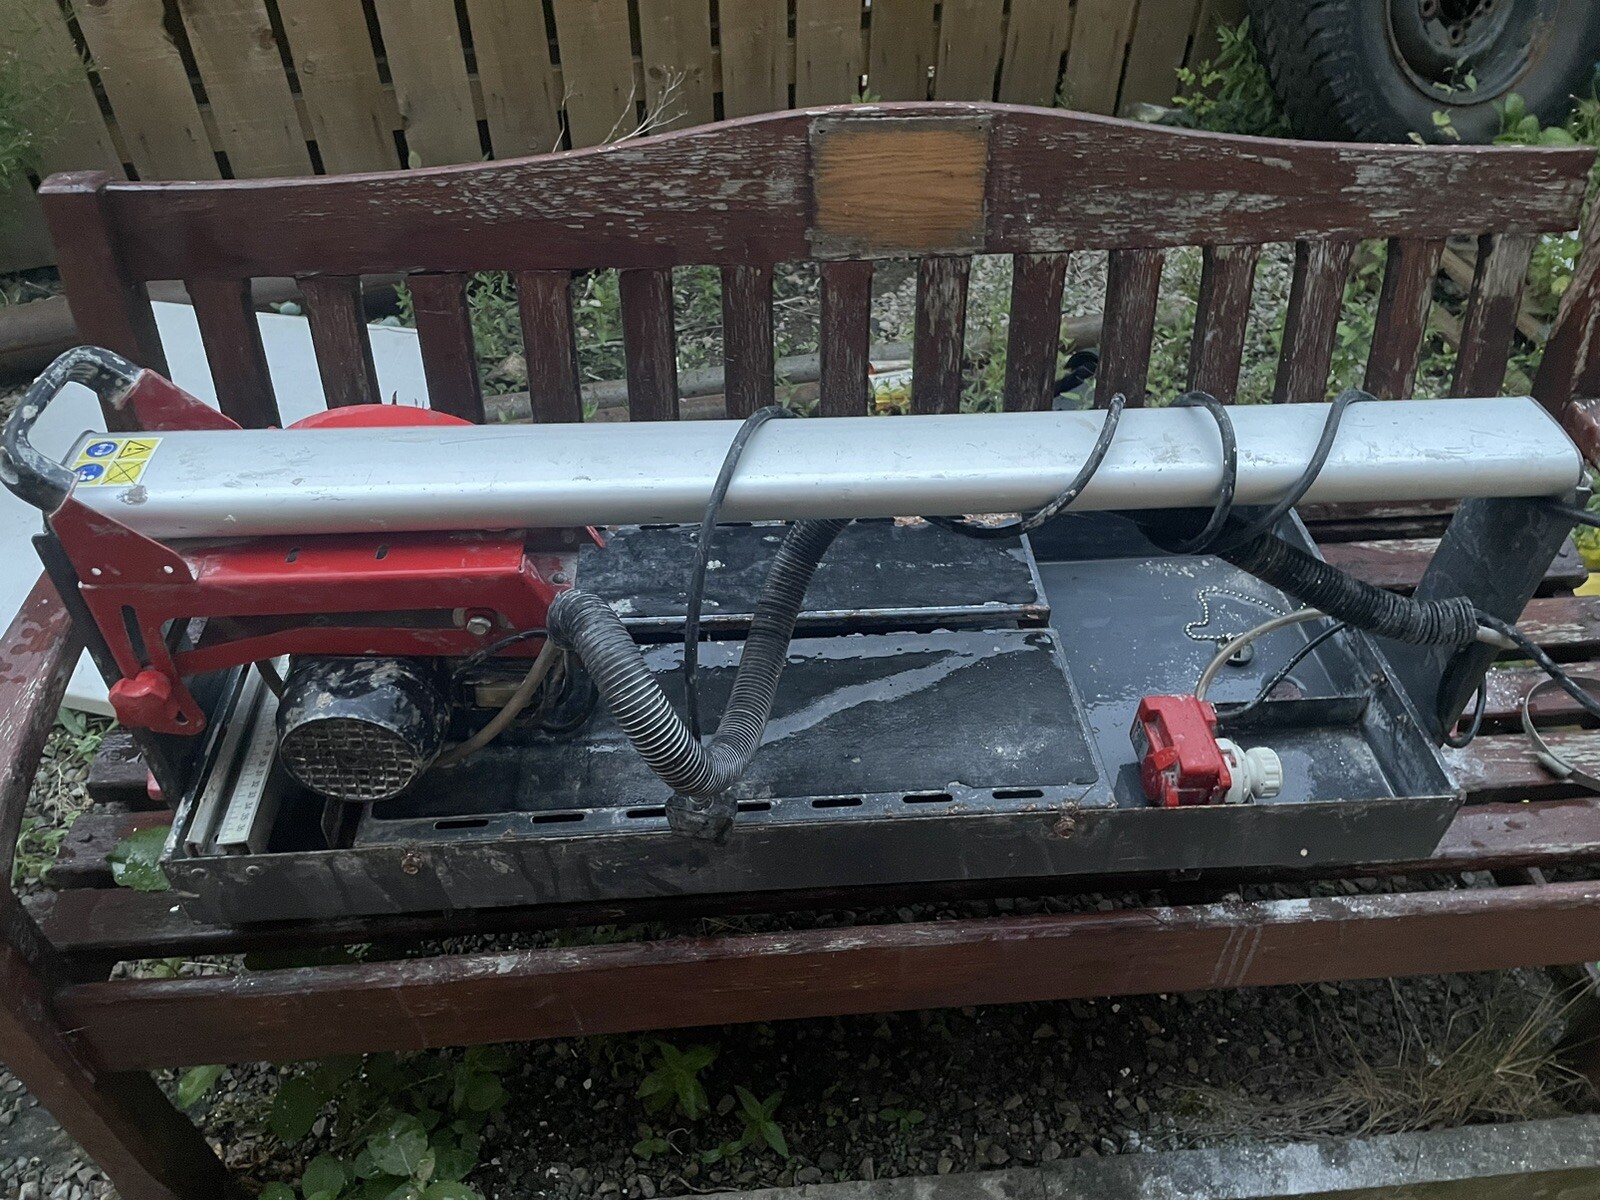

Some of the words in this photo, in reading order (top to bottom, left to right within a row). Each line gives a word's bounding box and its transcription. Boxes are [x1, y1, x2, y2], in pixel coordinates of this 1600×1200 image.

[251, 780, 261, 788] 32
[244, 801, 254, 809] 34
[240, 812, 250, 821] 35
[236, 823, 246, 832] 36
